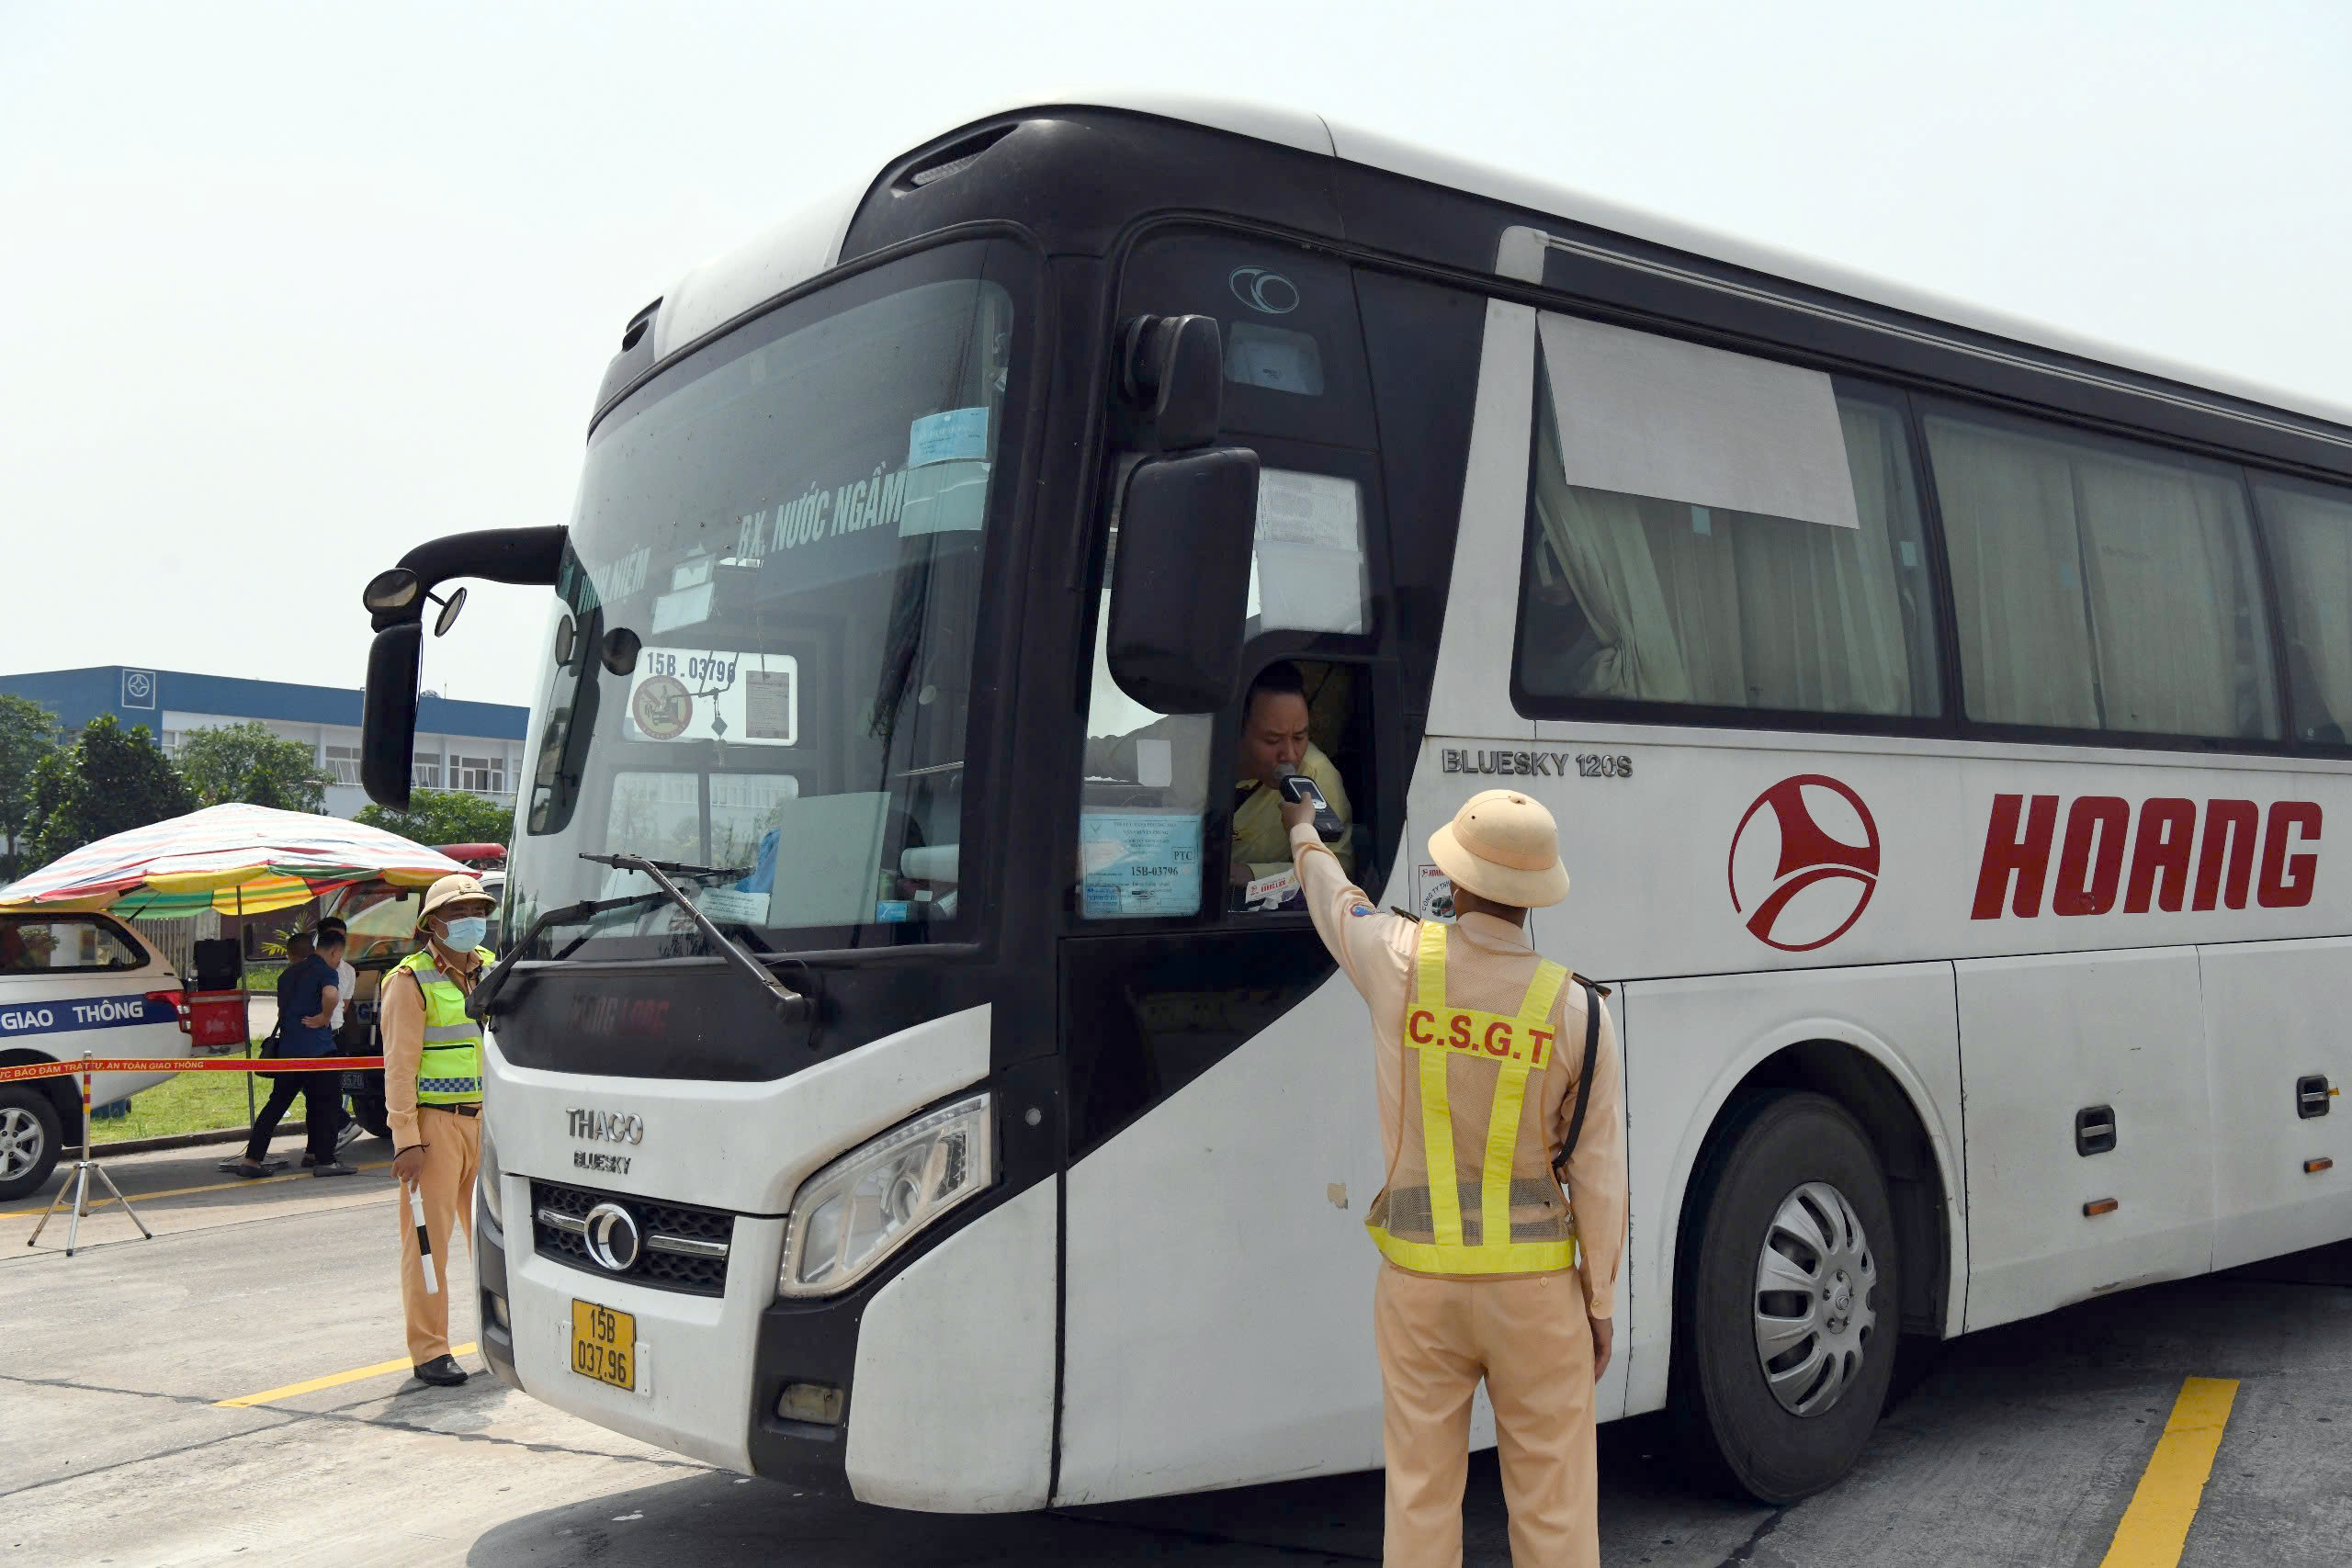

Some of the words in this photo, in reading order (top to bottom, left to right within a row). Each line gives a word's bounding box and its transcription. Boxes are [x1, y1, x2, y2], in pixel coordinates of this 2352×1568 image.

[772, 481, 830, 552] NƯỚC
[831, 461, 908, 536] NGẦM
[1442, 749, 1569, 776] BLUESKY
[1576, 754, 1634, 777] 120S
[1131, 866, 1178, 876] 15B-03796
[1174, 852, 1193, 861] PTC
[1971, 794, 2323, 920] HOANG
[1, 1010, 54, 1031] GIAO
[72, 999, 144, 1023] THÔNG
[1408, 1010, 1553, 1064] C.S.G.T
[107, 1061, 119, 1070] AN
[123, 1060, 146, 1070] TOÀN
[148, 1061, 172, 1070] GIAO
[174, 1058, 204, 1069] THÔNG
[566, 1108, 643, 1145] THACO
[573, 1151, 631, 1175] BLUESKY
[590, 1309, 616, 1343] 15B
[578, 1340, 627, 1383] 037.96
